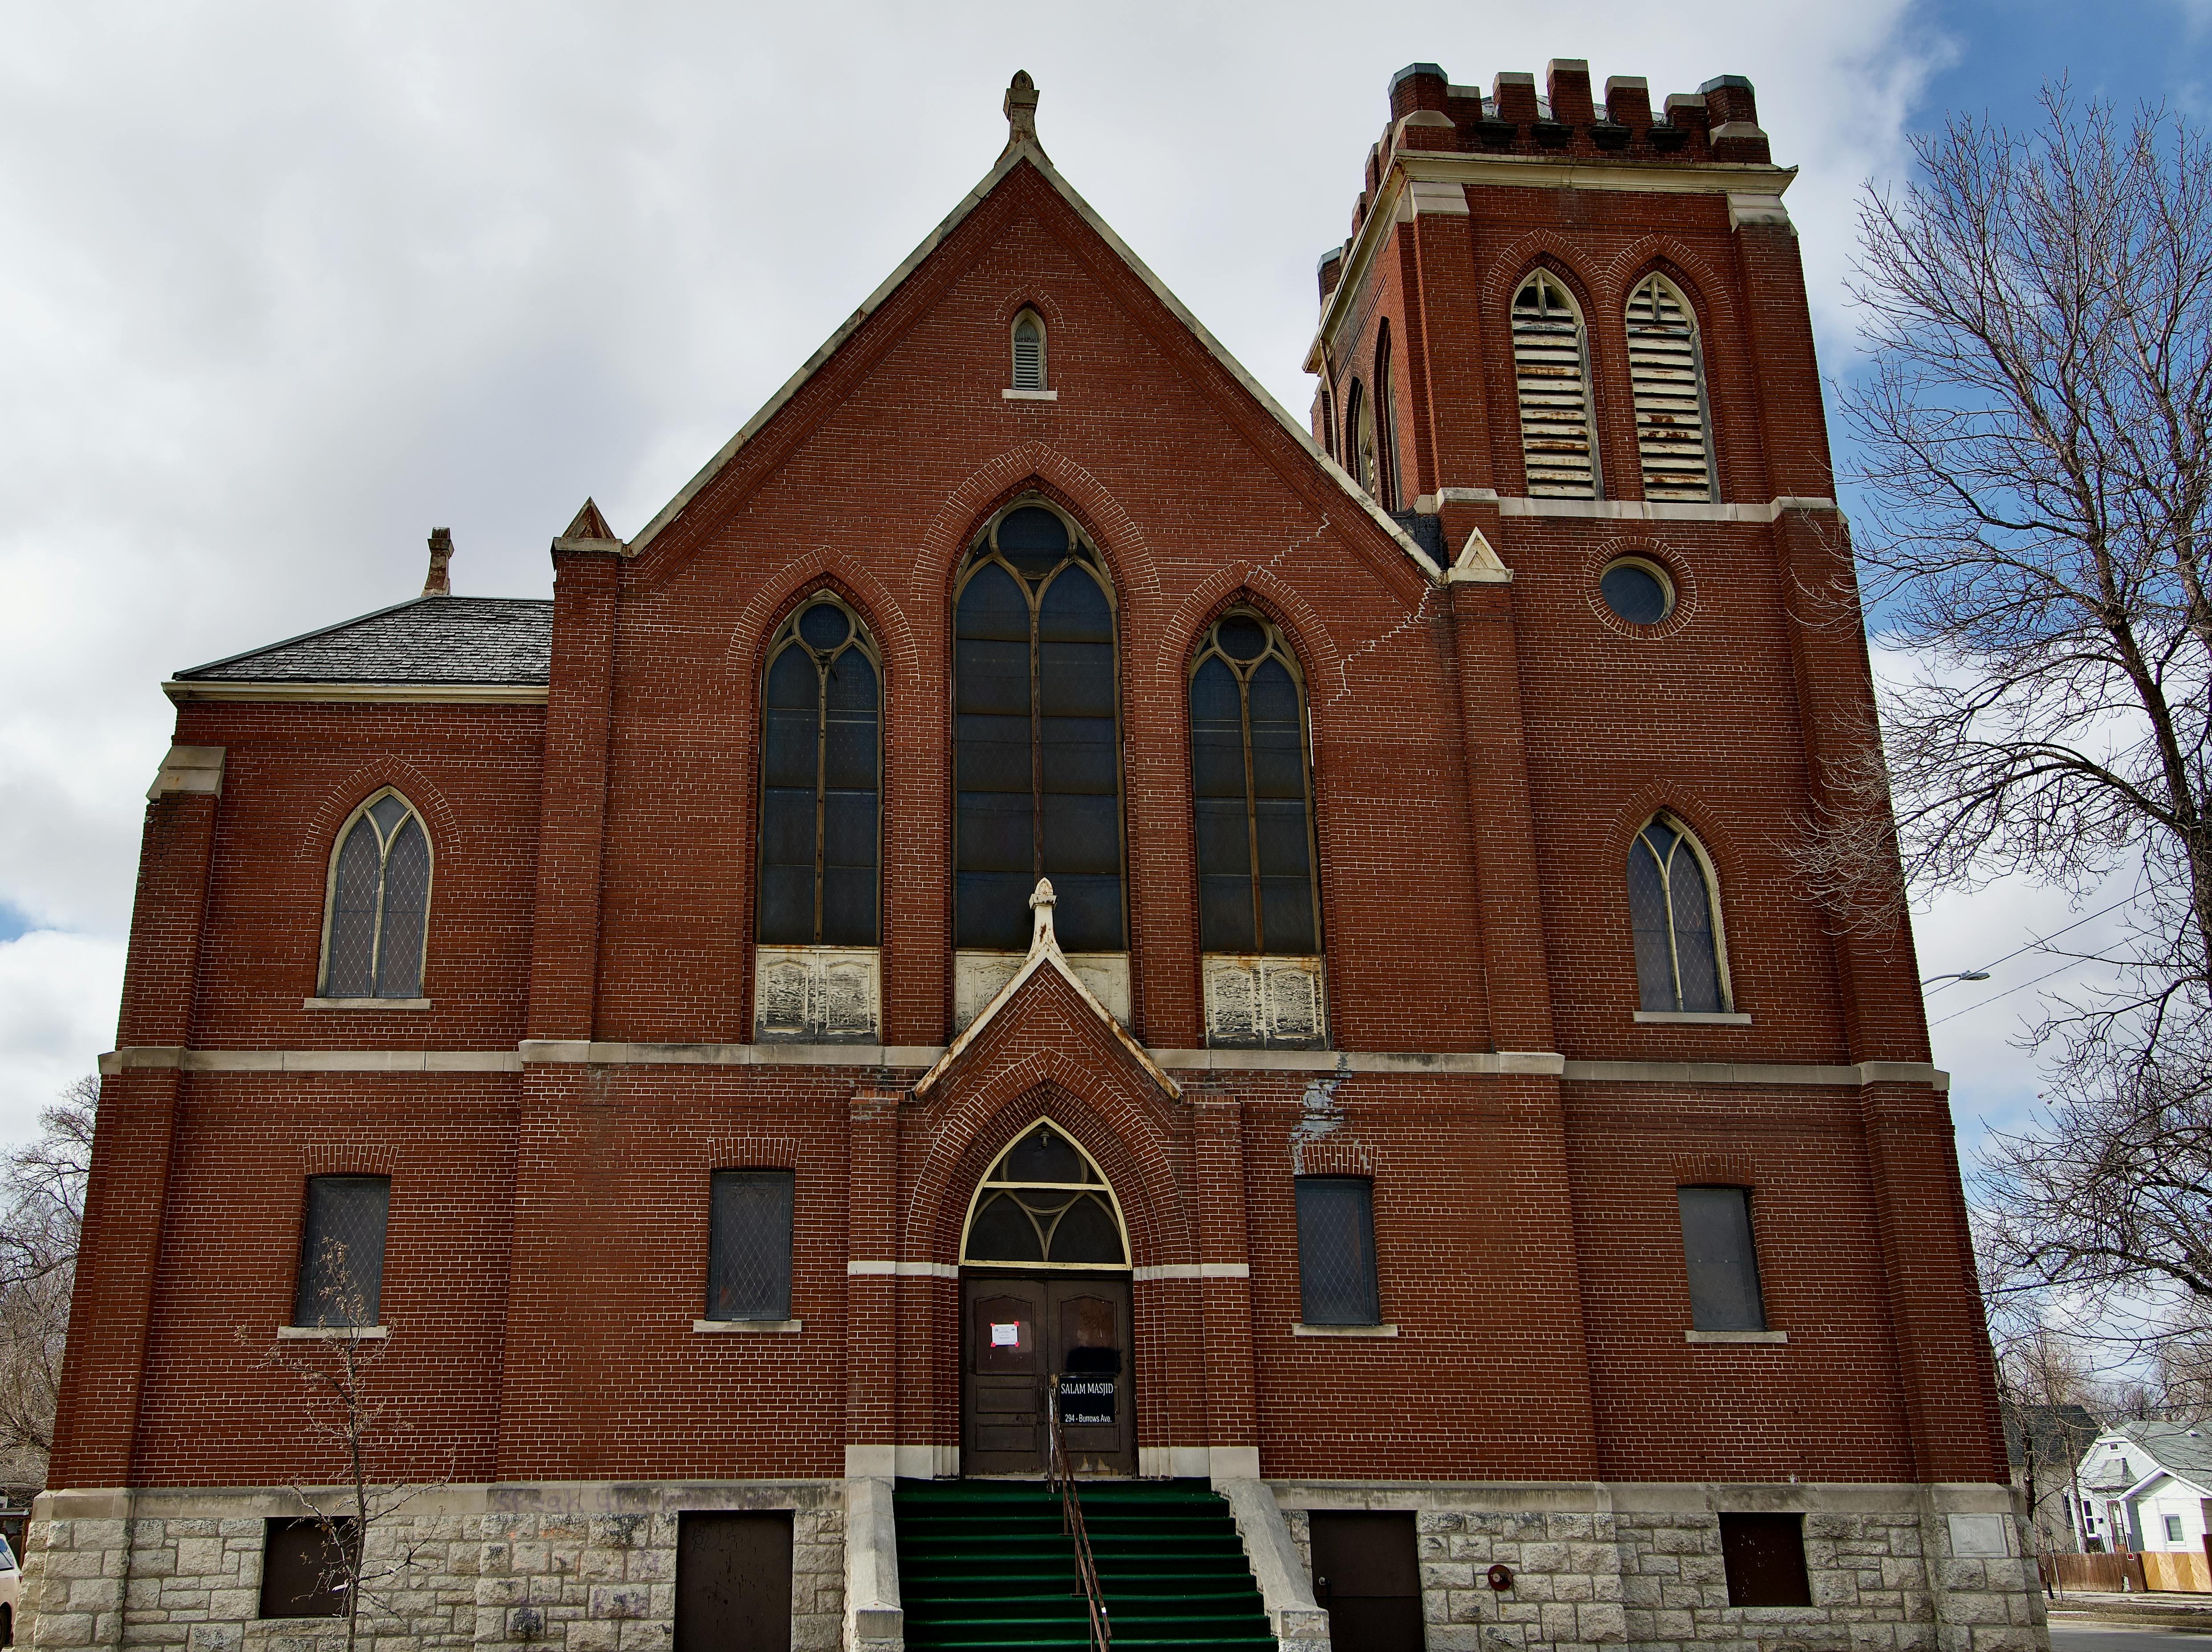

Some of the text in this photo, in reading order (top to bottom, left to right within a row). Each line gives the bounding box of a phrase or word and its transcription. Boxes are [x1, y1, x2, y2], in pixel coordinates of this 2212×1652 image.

[1061, 1383, 1113, 1396] SALAM MASJID
[1065, 1414, 1074, 1422] 294
[1079, 1414, 1100, 1423] Burrows
[1100, 1413, 1112, 1423] Ave.
